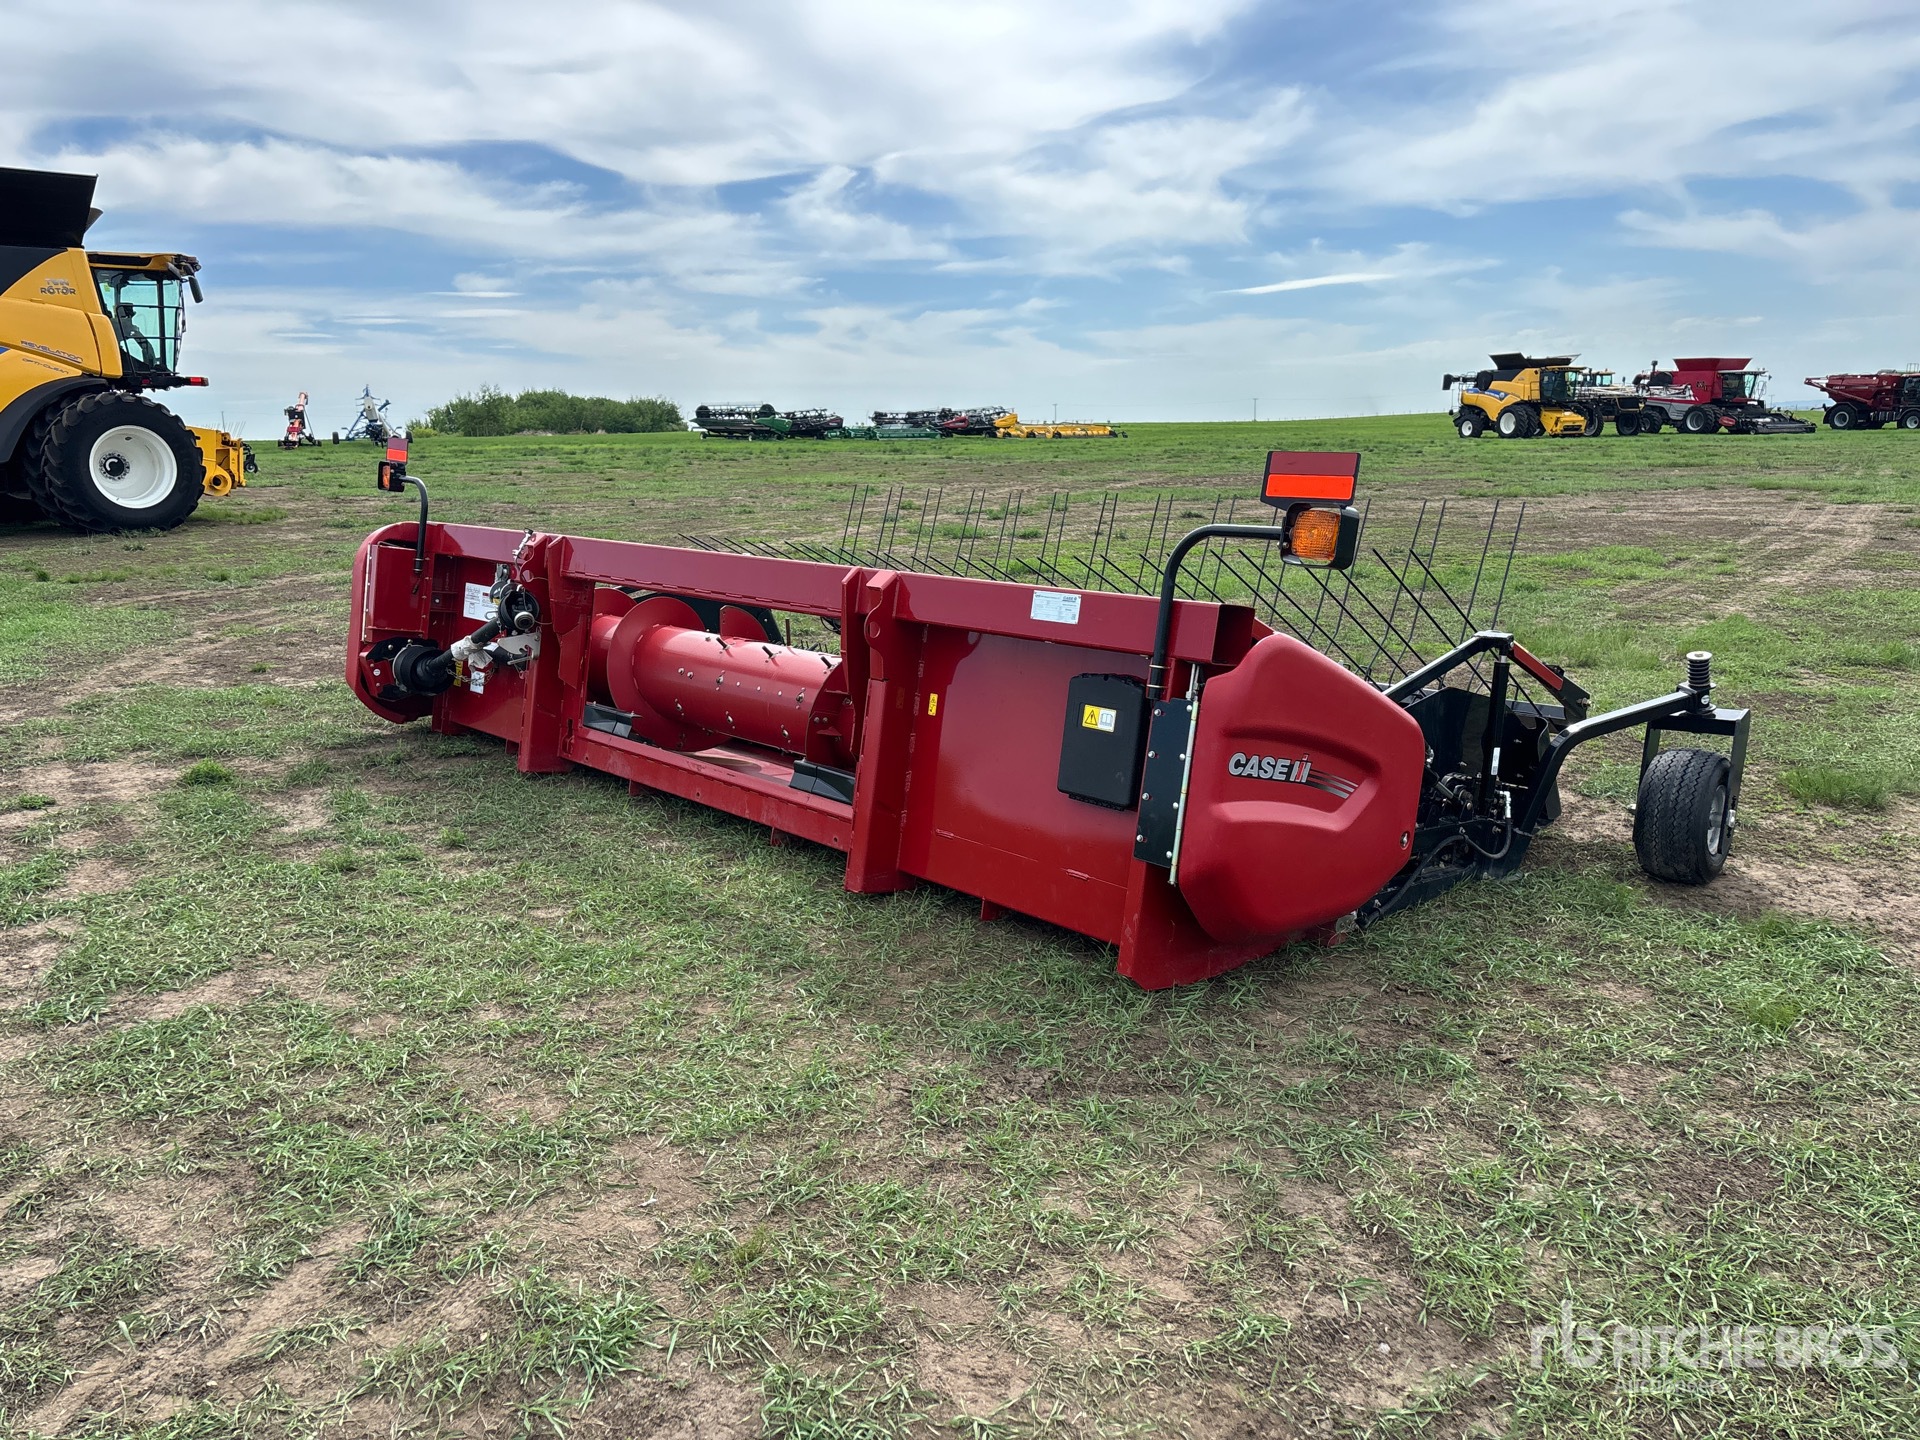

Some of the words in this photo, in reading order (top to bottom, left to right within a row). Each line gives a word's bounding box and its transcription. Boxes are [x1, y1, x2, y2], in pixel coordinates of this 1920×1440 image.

[40, 286, 77, 295] ROTOR
[20, 340, 83, 362] REVELATION
[1228, 752, 1291, 781] CASE
